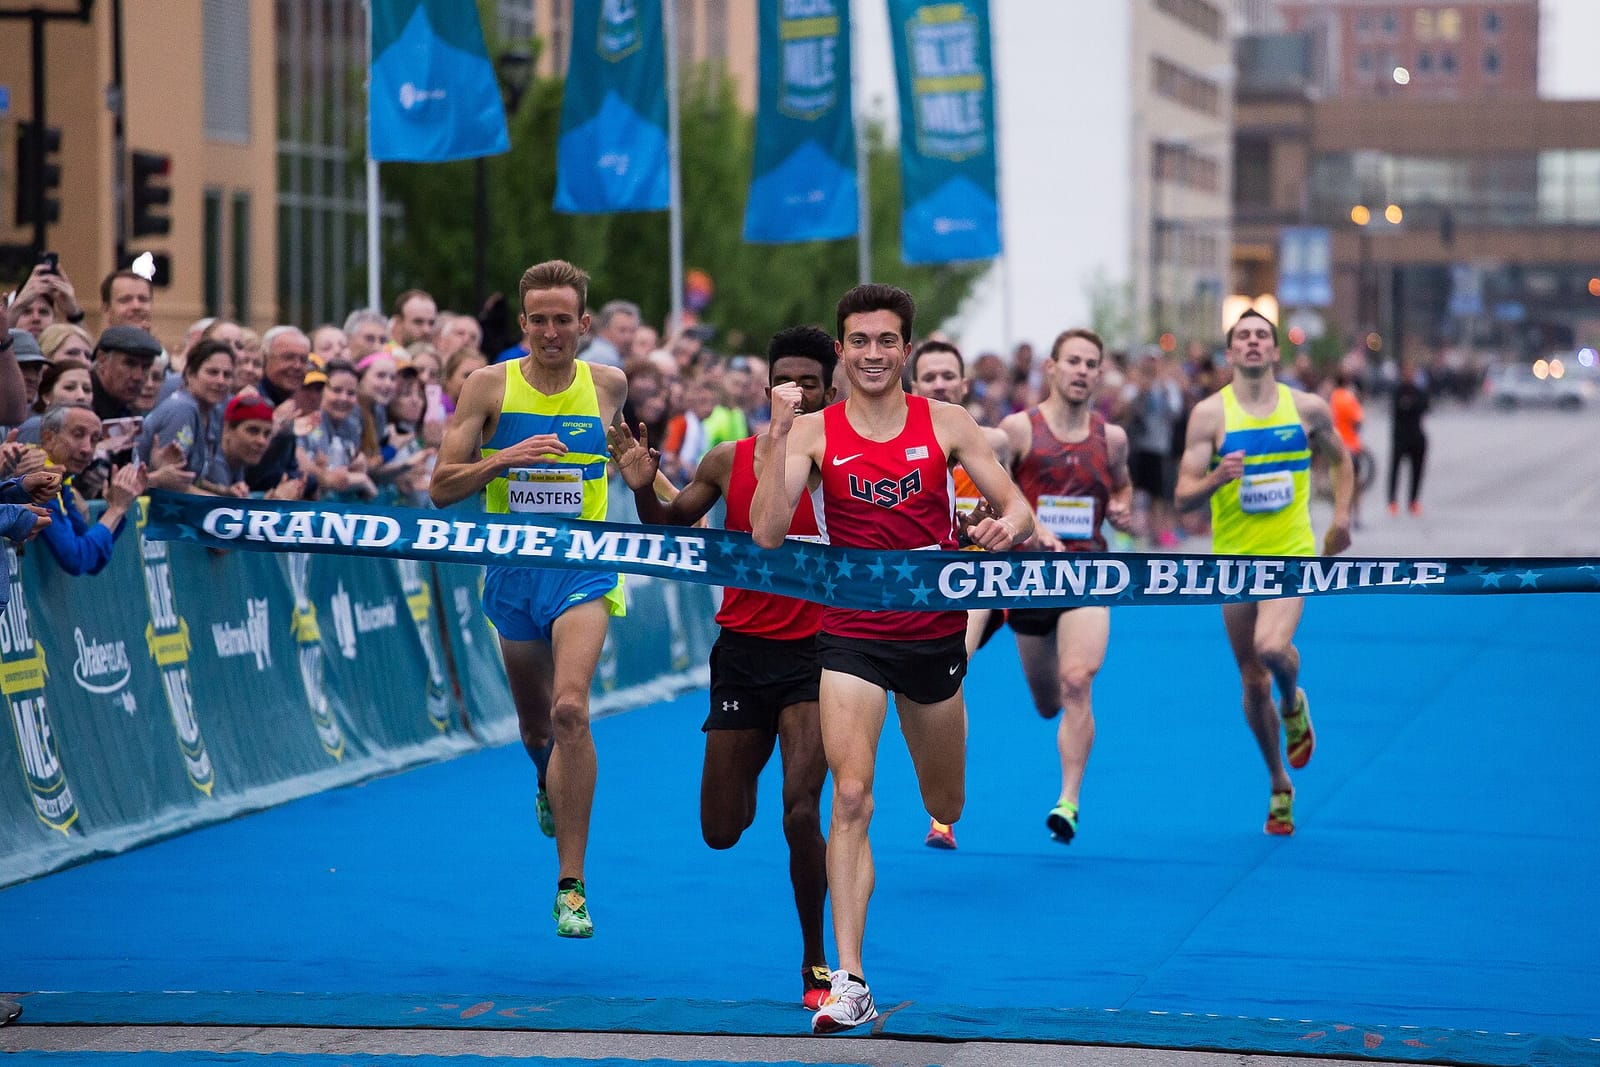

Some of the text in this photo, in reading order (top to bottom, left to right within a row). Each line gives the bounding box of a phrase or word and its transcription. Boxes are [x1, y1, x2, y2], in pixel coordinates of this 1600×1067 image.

[921, 90, 984, 134] MILE
[510, 490, 582, 505] MASTERS
[848, 467, 922, 509] USA
[1241, 487, 1291, 503] WINDLE
[202, 507, 401, 547] GRAND
[412, 518, 557, 556] BLUE
[565, 529, 707, 572] MILE
[1039, 514, 1090, 525] NIERMAN
[938, 559, 1447, 599] GRAND BLUE MILE
[74, 626, 107, 677] Drake
[13, 696, 59, 779] MILE
